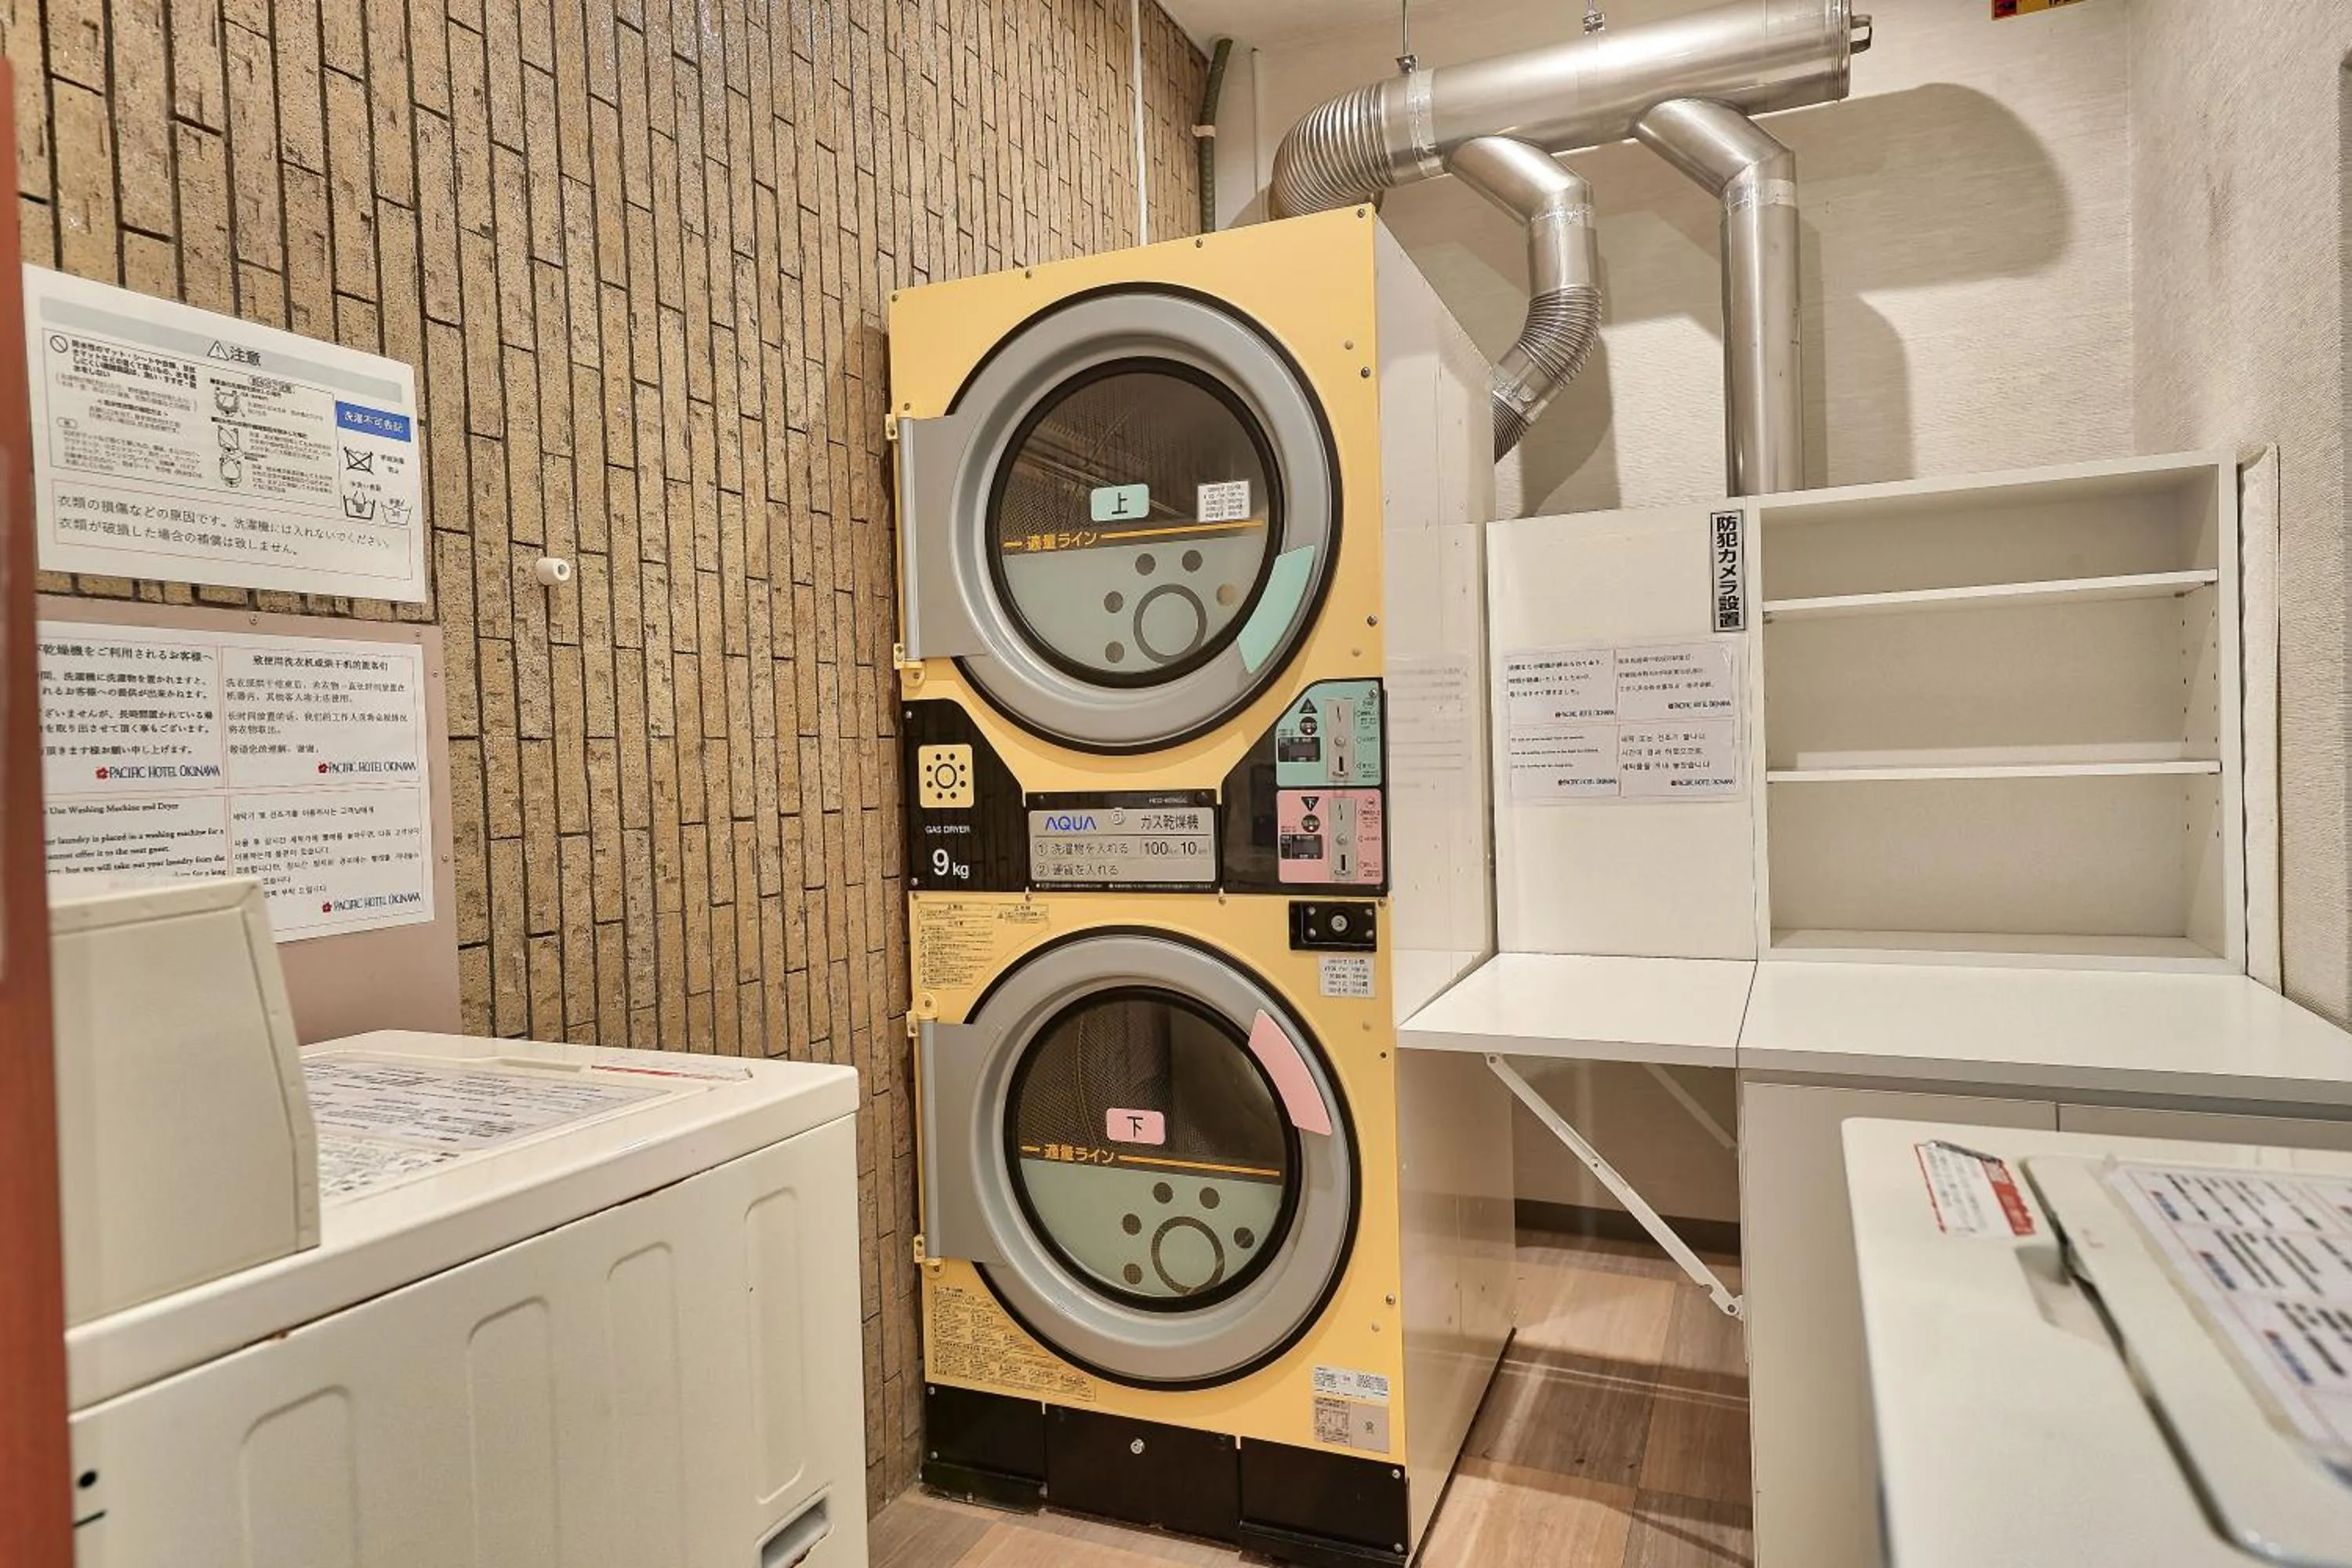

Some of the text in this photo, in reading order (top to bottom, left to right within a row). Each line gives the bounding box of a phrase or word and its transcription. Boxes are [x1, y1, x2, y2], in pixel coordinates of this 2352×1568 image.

[230, 346, 261, 367] 注意
[1112, 492, 1128, 515] 上
[1026, 532, 1097, 550] 適量ライン
[1716, 516, 1740, 627] 防犯カメラ設置
[37, 644, 214, 662] 乾燥機をご利用されるお客様へ
[39, 708, 213, 720] ざいませんが、長時間置かれている場
[40, 746, 193, 756] 頂きます様お願い申し上げます。
[109, 764, 220, 779] PACIFIC HOTEL OKINAWA
[358, 761, 382, 772] HOTEL
[68, 806, 104, 815] Washing
[158, 802, 179, 811] Dryer
[1045, 815, 1097, 831] AQUA
[1127, 1116, 1144, 1137] 下
[1044, 1144, 1116, 1164] 適量ライン
